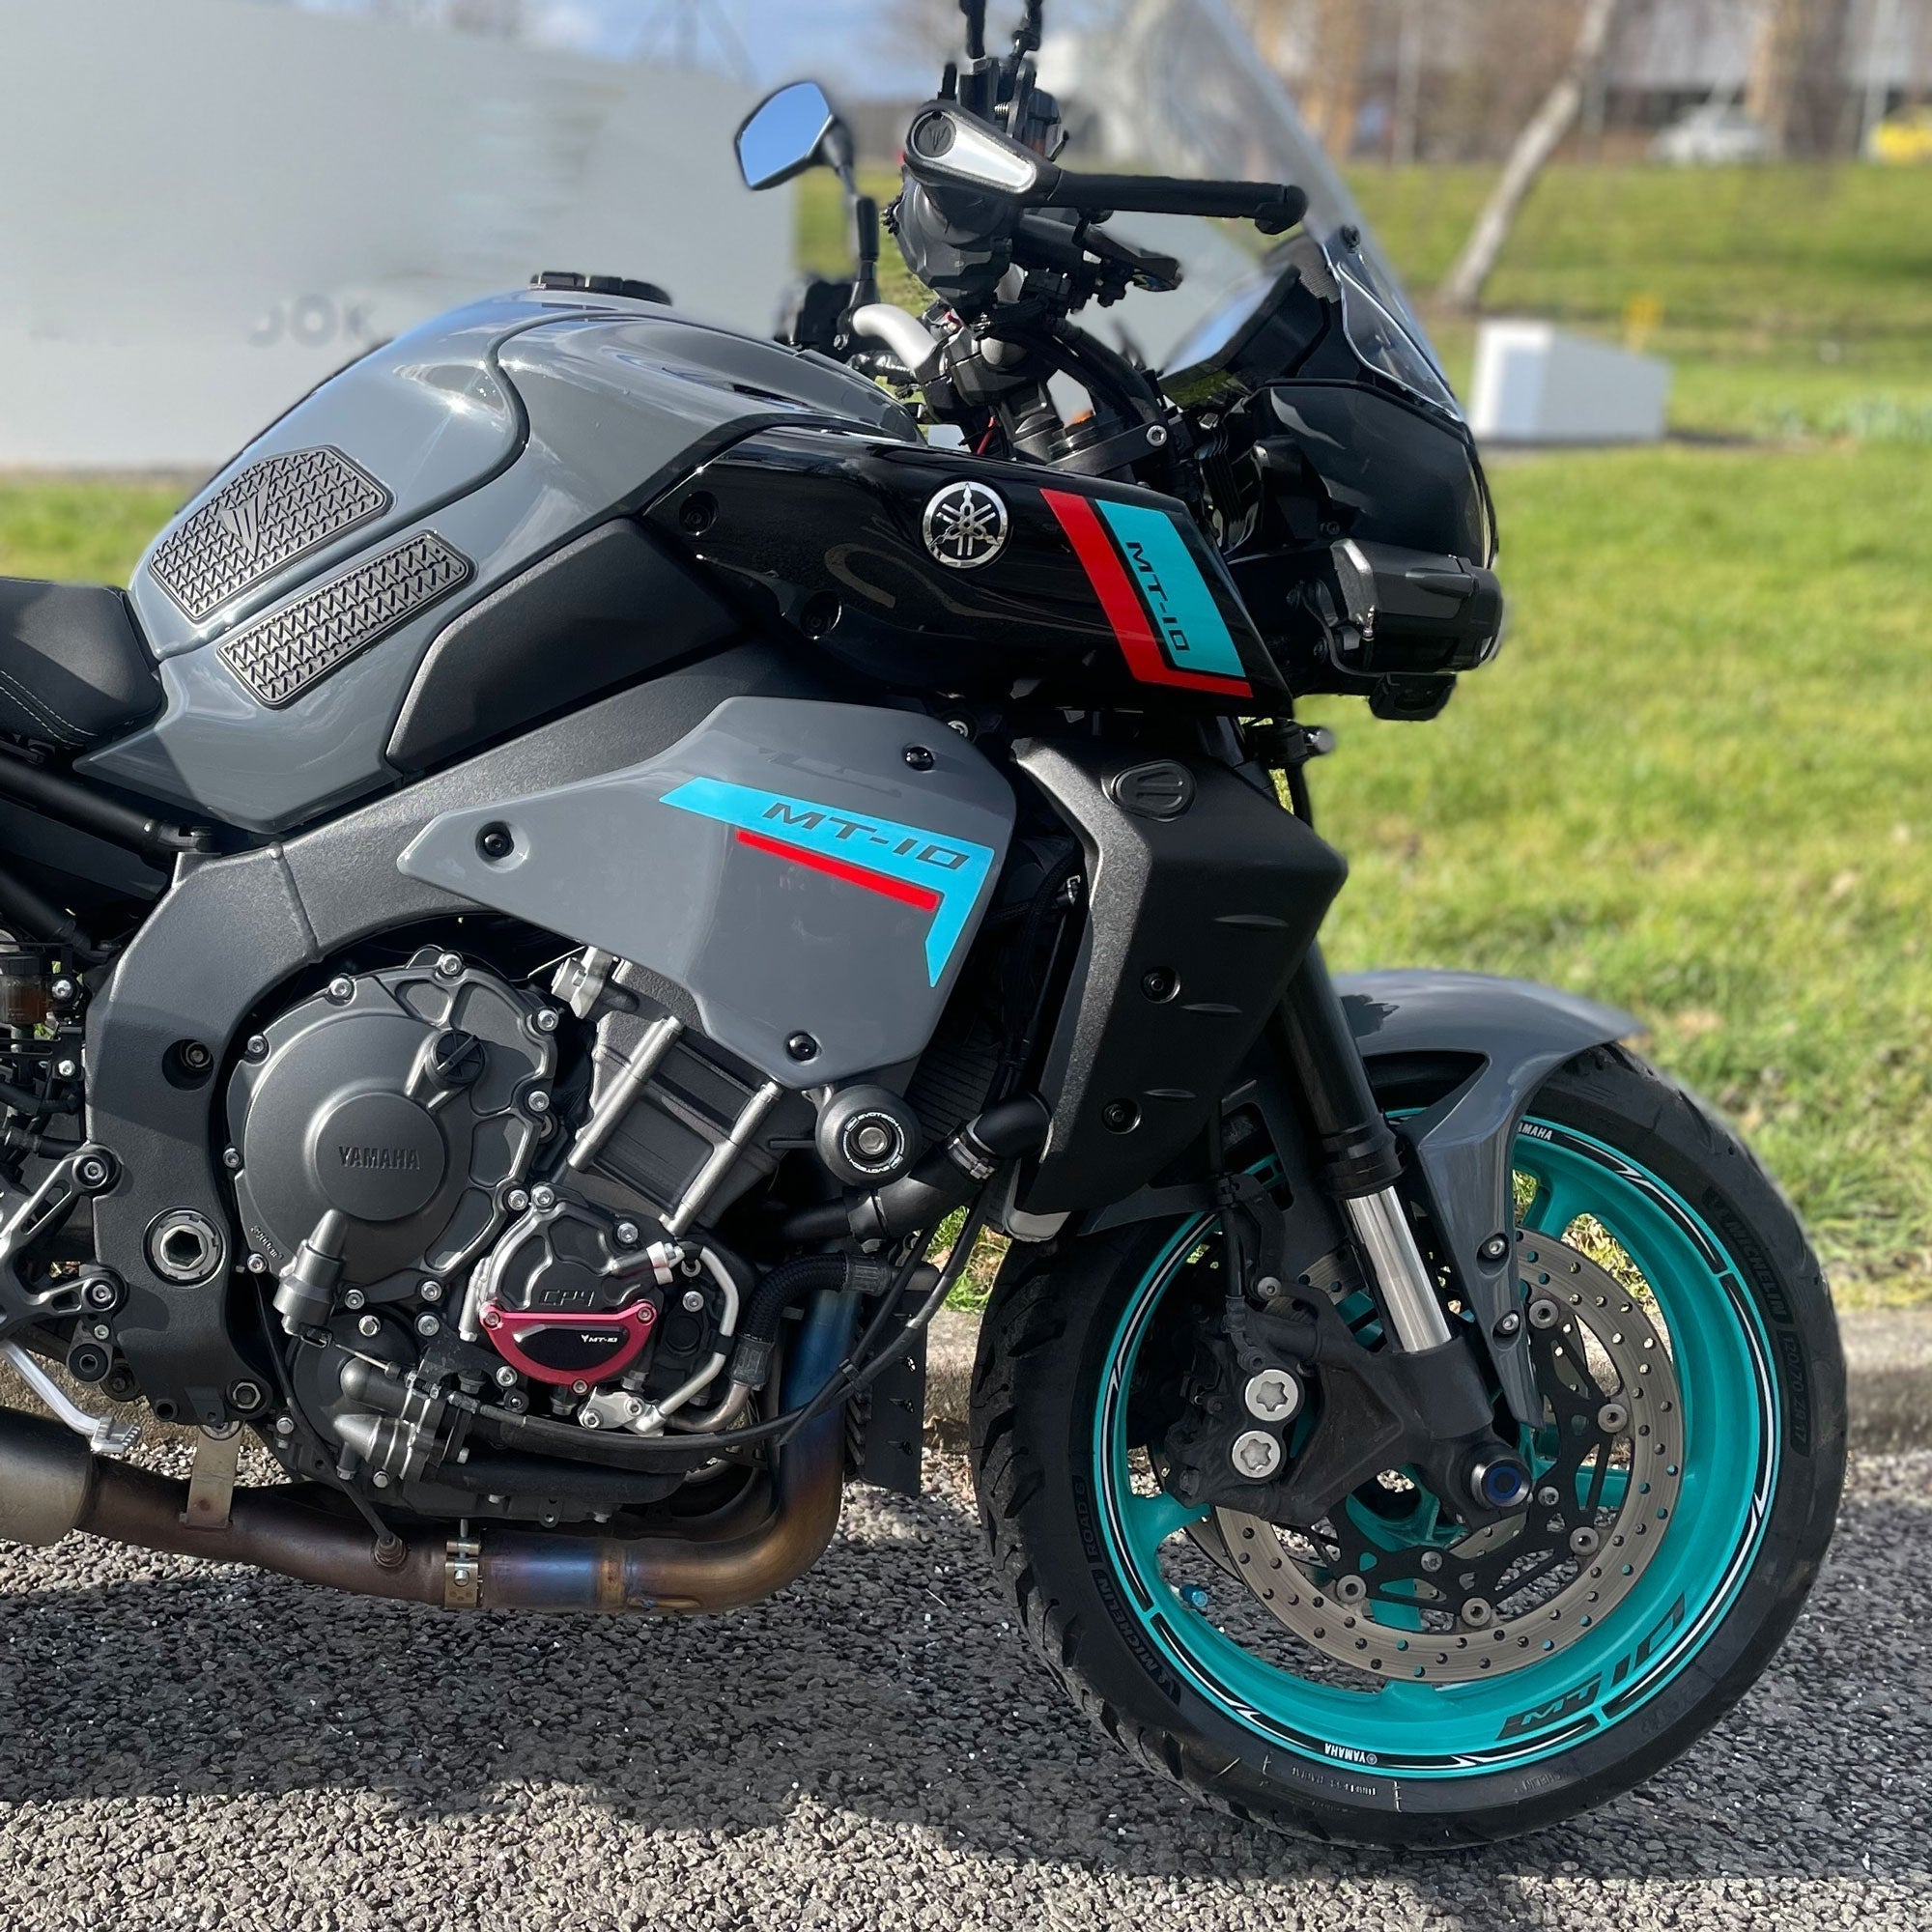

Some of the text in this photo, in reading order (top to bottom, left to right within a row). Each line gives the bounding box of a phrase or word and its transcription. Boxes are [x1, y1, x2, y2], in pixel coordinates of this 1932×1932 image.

[1125, 542, 1191, 651] MT-10
[762, 802, 971, 870] MT-10
[338, 1146, 421, 1171] YAMAHA
[538, 1289, 596, 1307] CP4
[1723, 1219, 1787, 1318] MICHELIN
[1078, 1502, 1098, 1557] ROAD
[1094, 1577, 1159, 1673] MICHELIN
[1324, 1743, 1367, 1764] YAMAHA
